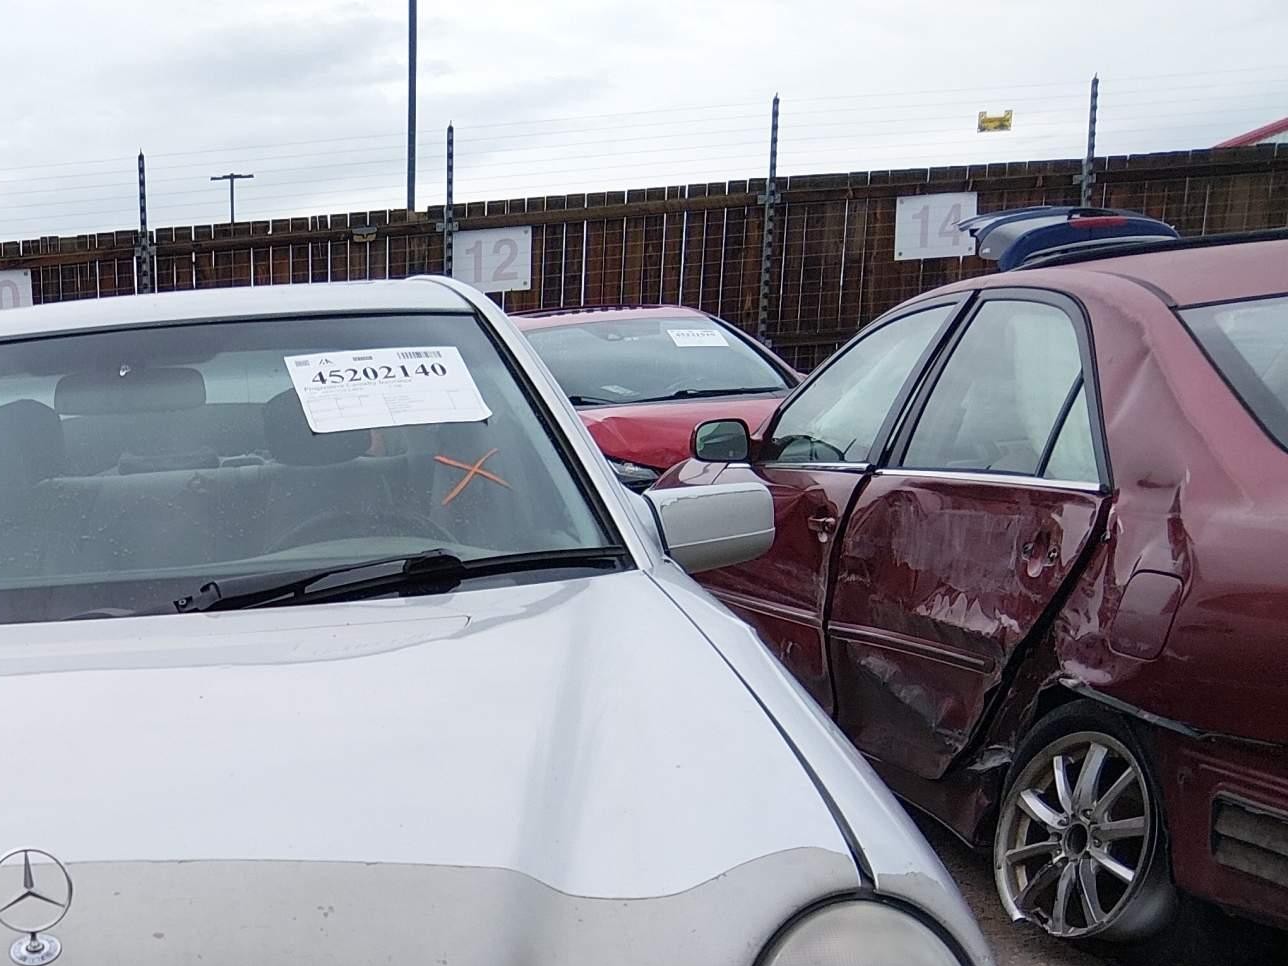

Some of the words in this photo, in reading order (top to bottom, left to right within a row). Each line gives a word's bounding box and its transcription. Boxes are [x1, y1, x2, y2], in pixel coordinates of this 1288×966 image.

[912, 203, 961, 248] 14
[465, 238, 519, 283] 12
[312, 362, 447, 384] 45202140
